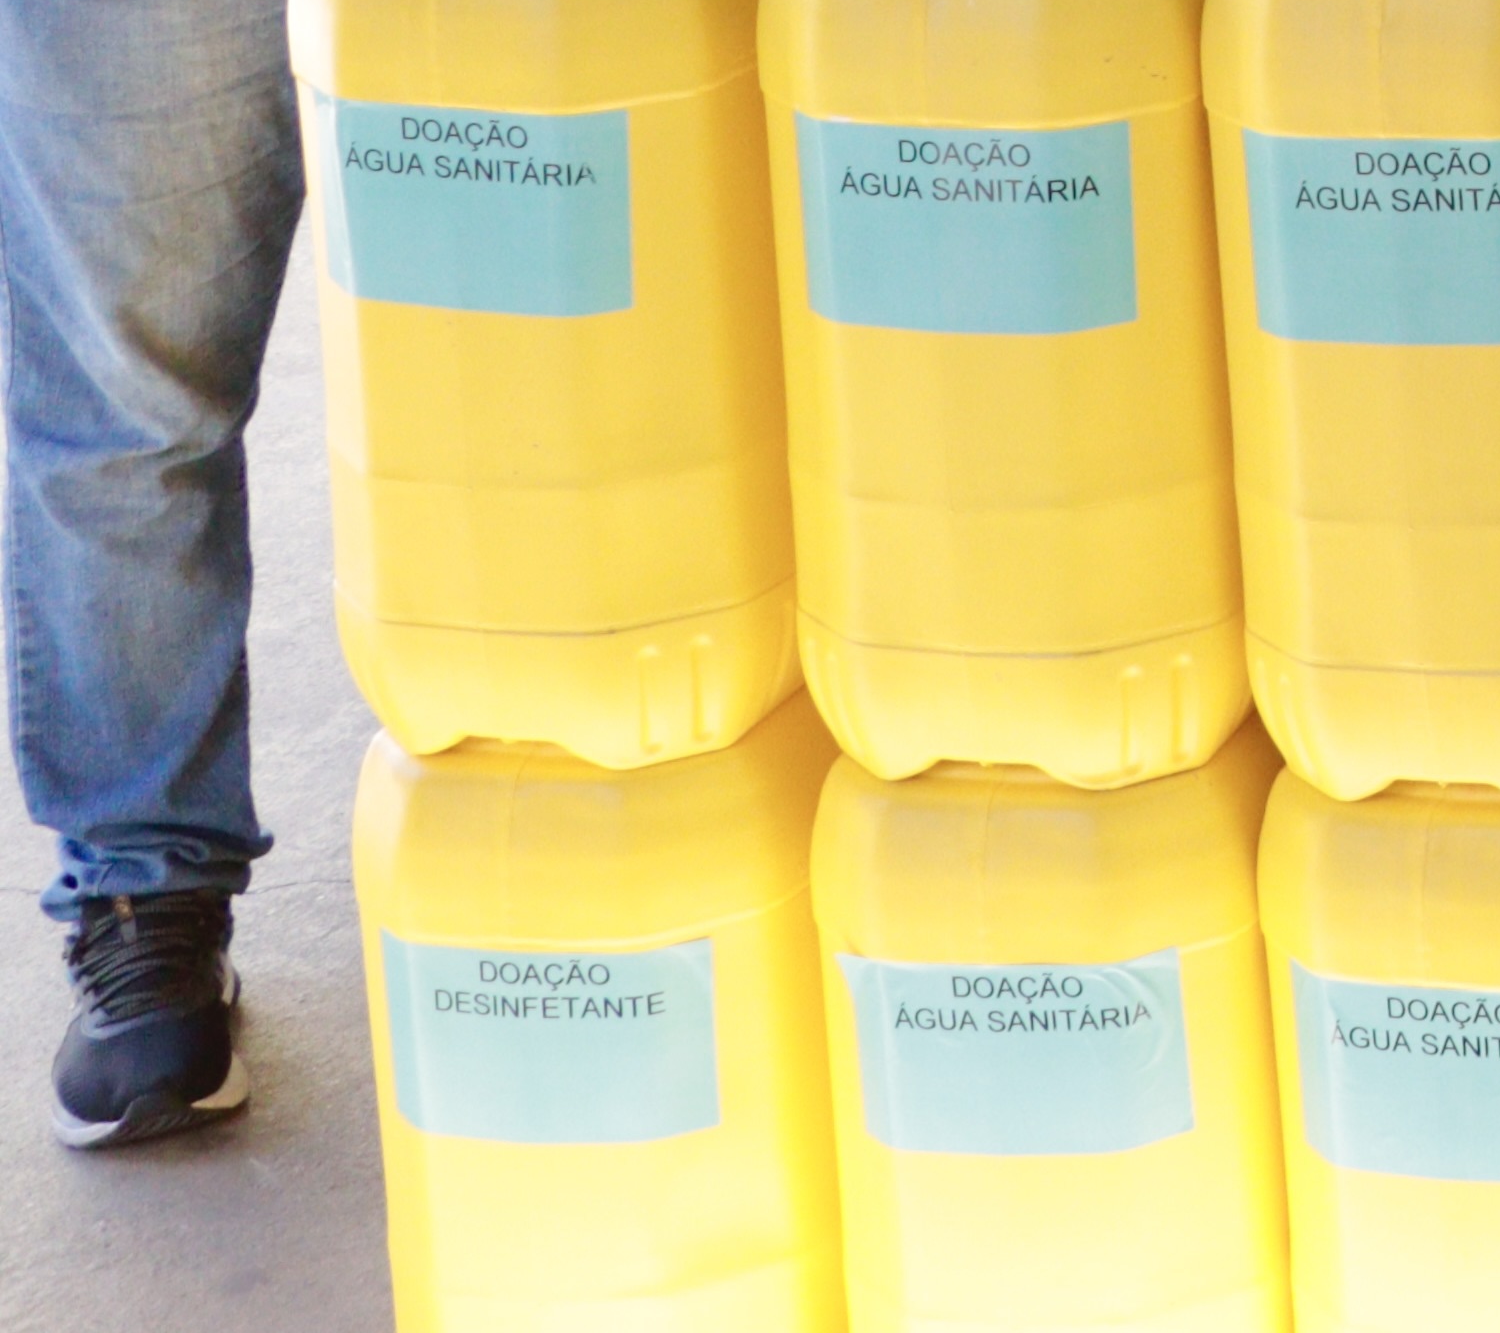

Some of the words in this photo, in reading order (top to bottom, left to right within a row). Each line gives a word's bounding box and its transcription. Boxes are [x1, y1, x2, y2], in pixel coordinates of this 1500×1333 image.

[401, 117, 528, 151] DOAÇÃO
[345, 142, 425, 177] ÁGUA
[435, 154, 596, 187] SANITÁRIA
[898, 138, 1031, 172] DOAÇÃO
[1354, 148, 1491, 182] DOAÇÃO
[840, 166, 922, 201] ÁGUA
[932, 174, 1100, 204] SANITÁRIA
[1295, 178, 1381, 211] ÁGUA
[478, 959, 610, 992] DOAÇÃO
[951, 973, 1083, 1006] DOAÇÃO
[435, 989, 665, 1020] DESINFETANTE
[895, 1002, 978, 1033] ÁGUA
[987, 1002, 1152, 1033] SANITÁRIA
[1331, 1019, 1412, 1054] ÁGUA
